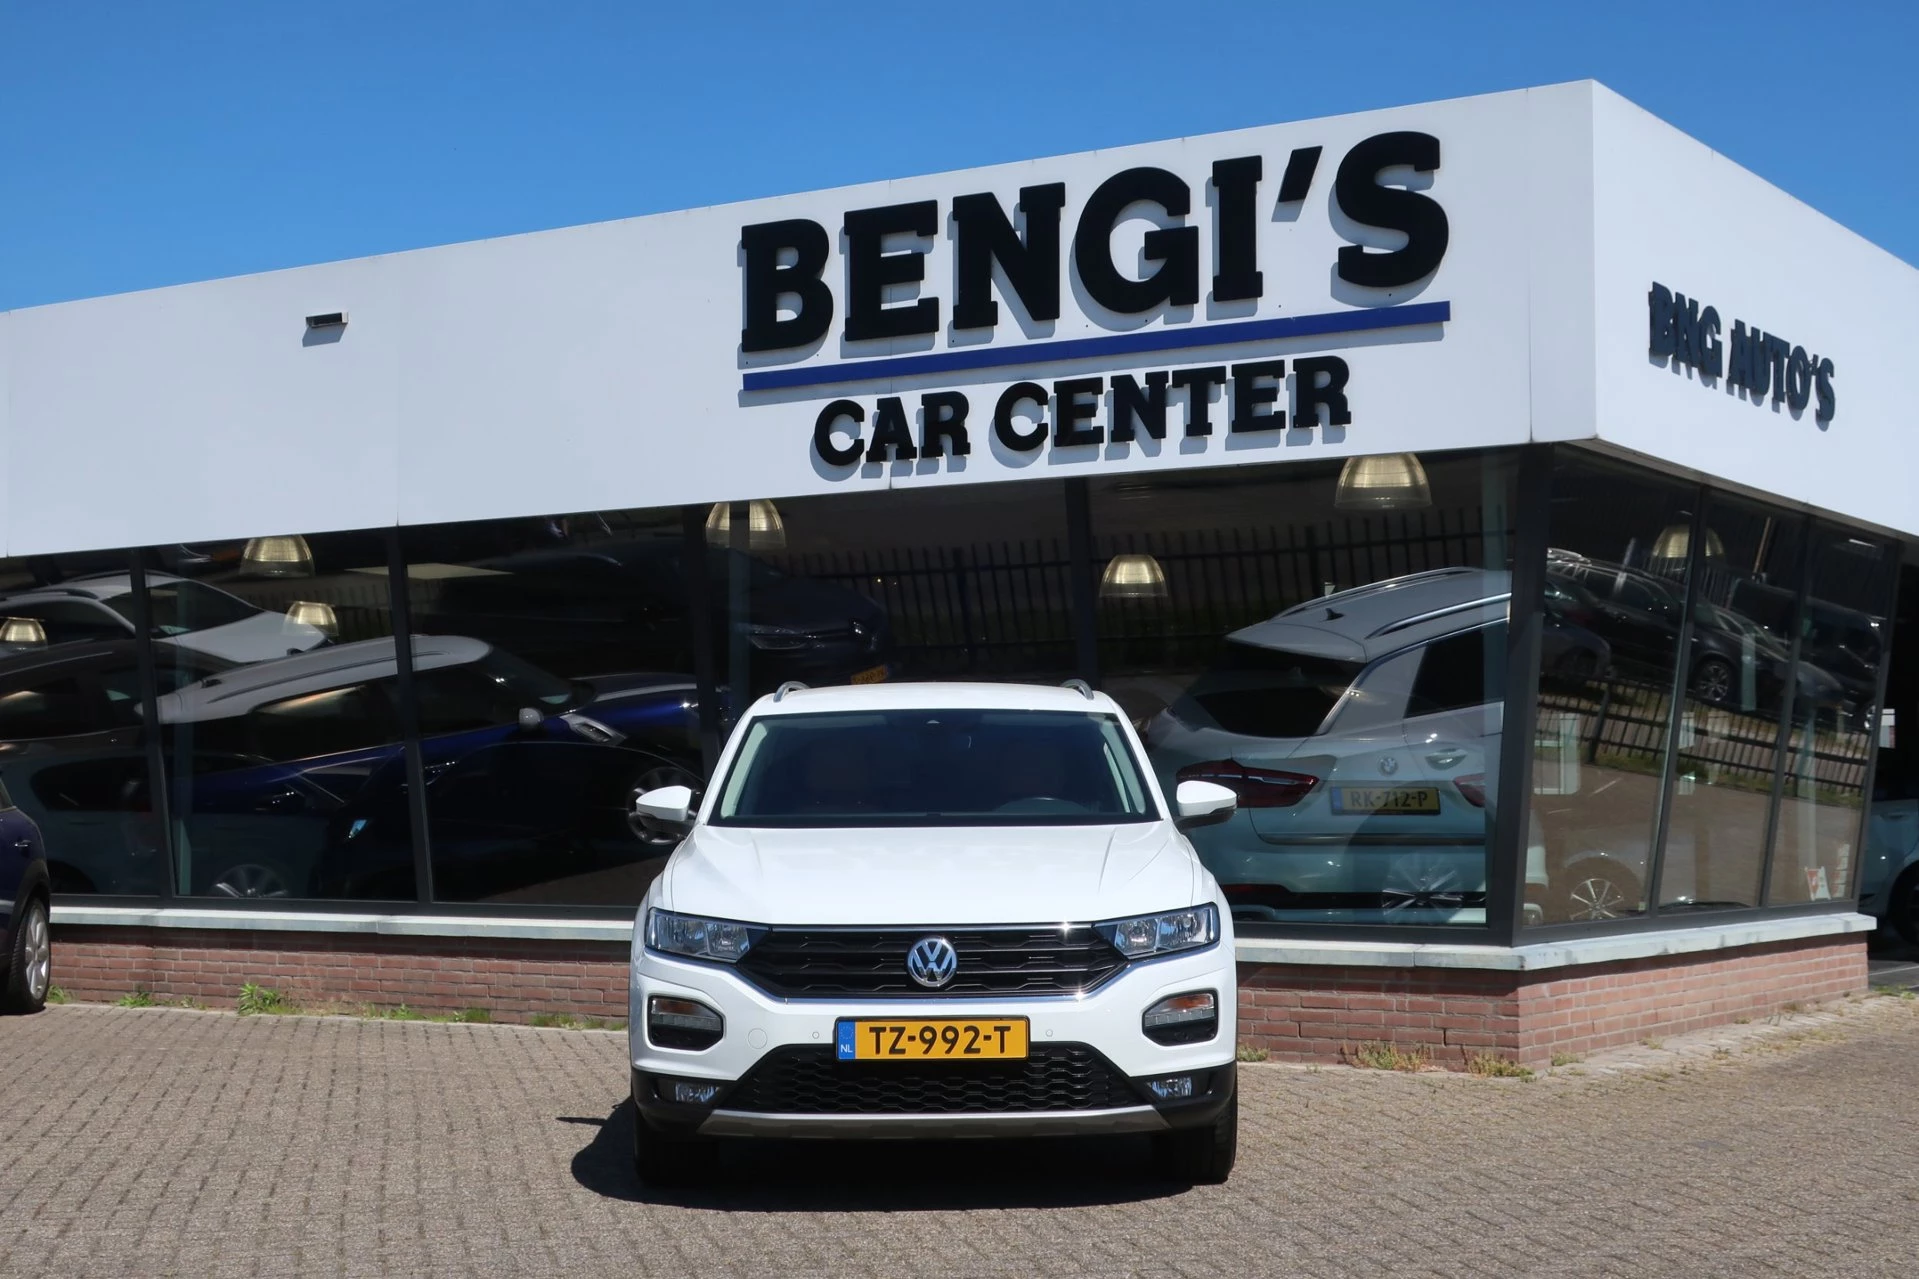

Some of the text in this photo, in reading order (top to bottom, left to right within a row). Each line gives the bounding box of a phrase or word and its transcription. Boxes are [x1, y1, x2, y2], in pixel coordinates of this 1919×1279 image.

[741, 131, 1450, 353] BENGI'S
[1648, 281, 1836, 422] BNG AUTO'S
[814, 355, 1352, 467] CAR CENTER
[1350, 790, 1428, 808] RK-712-P
[908, 937, 957, 987] VW
[840, 1044, 853, 1054] NL
[868, 1025, 1012, 1056] TZ-992-T
